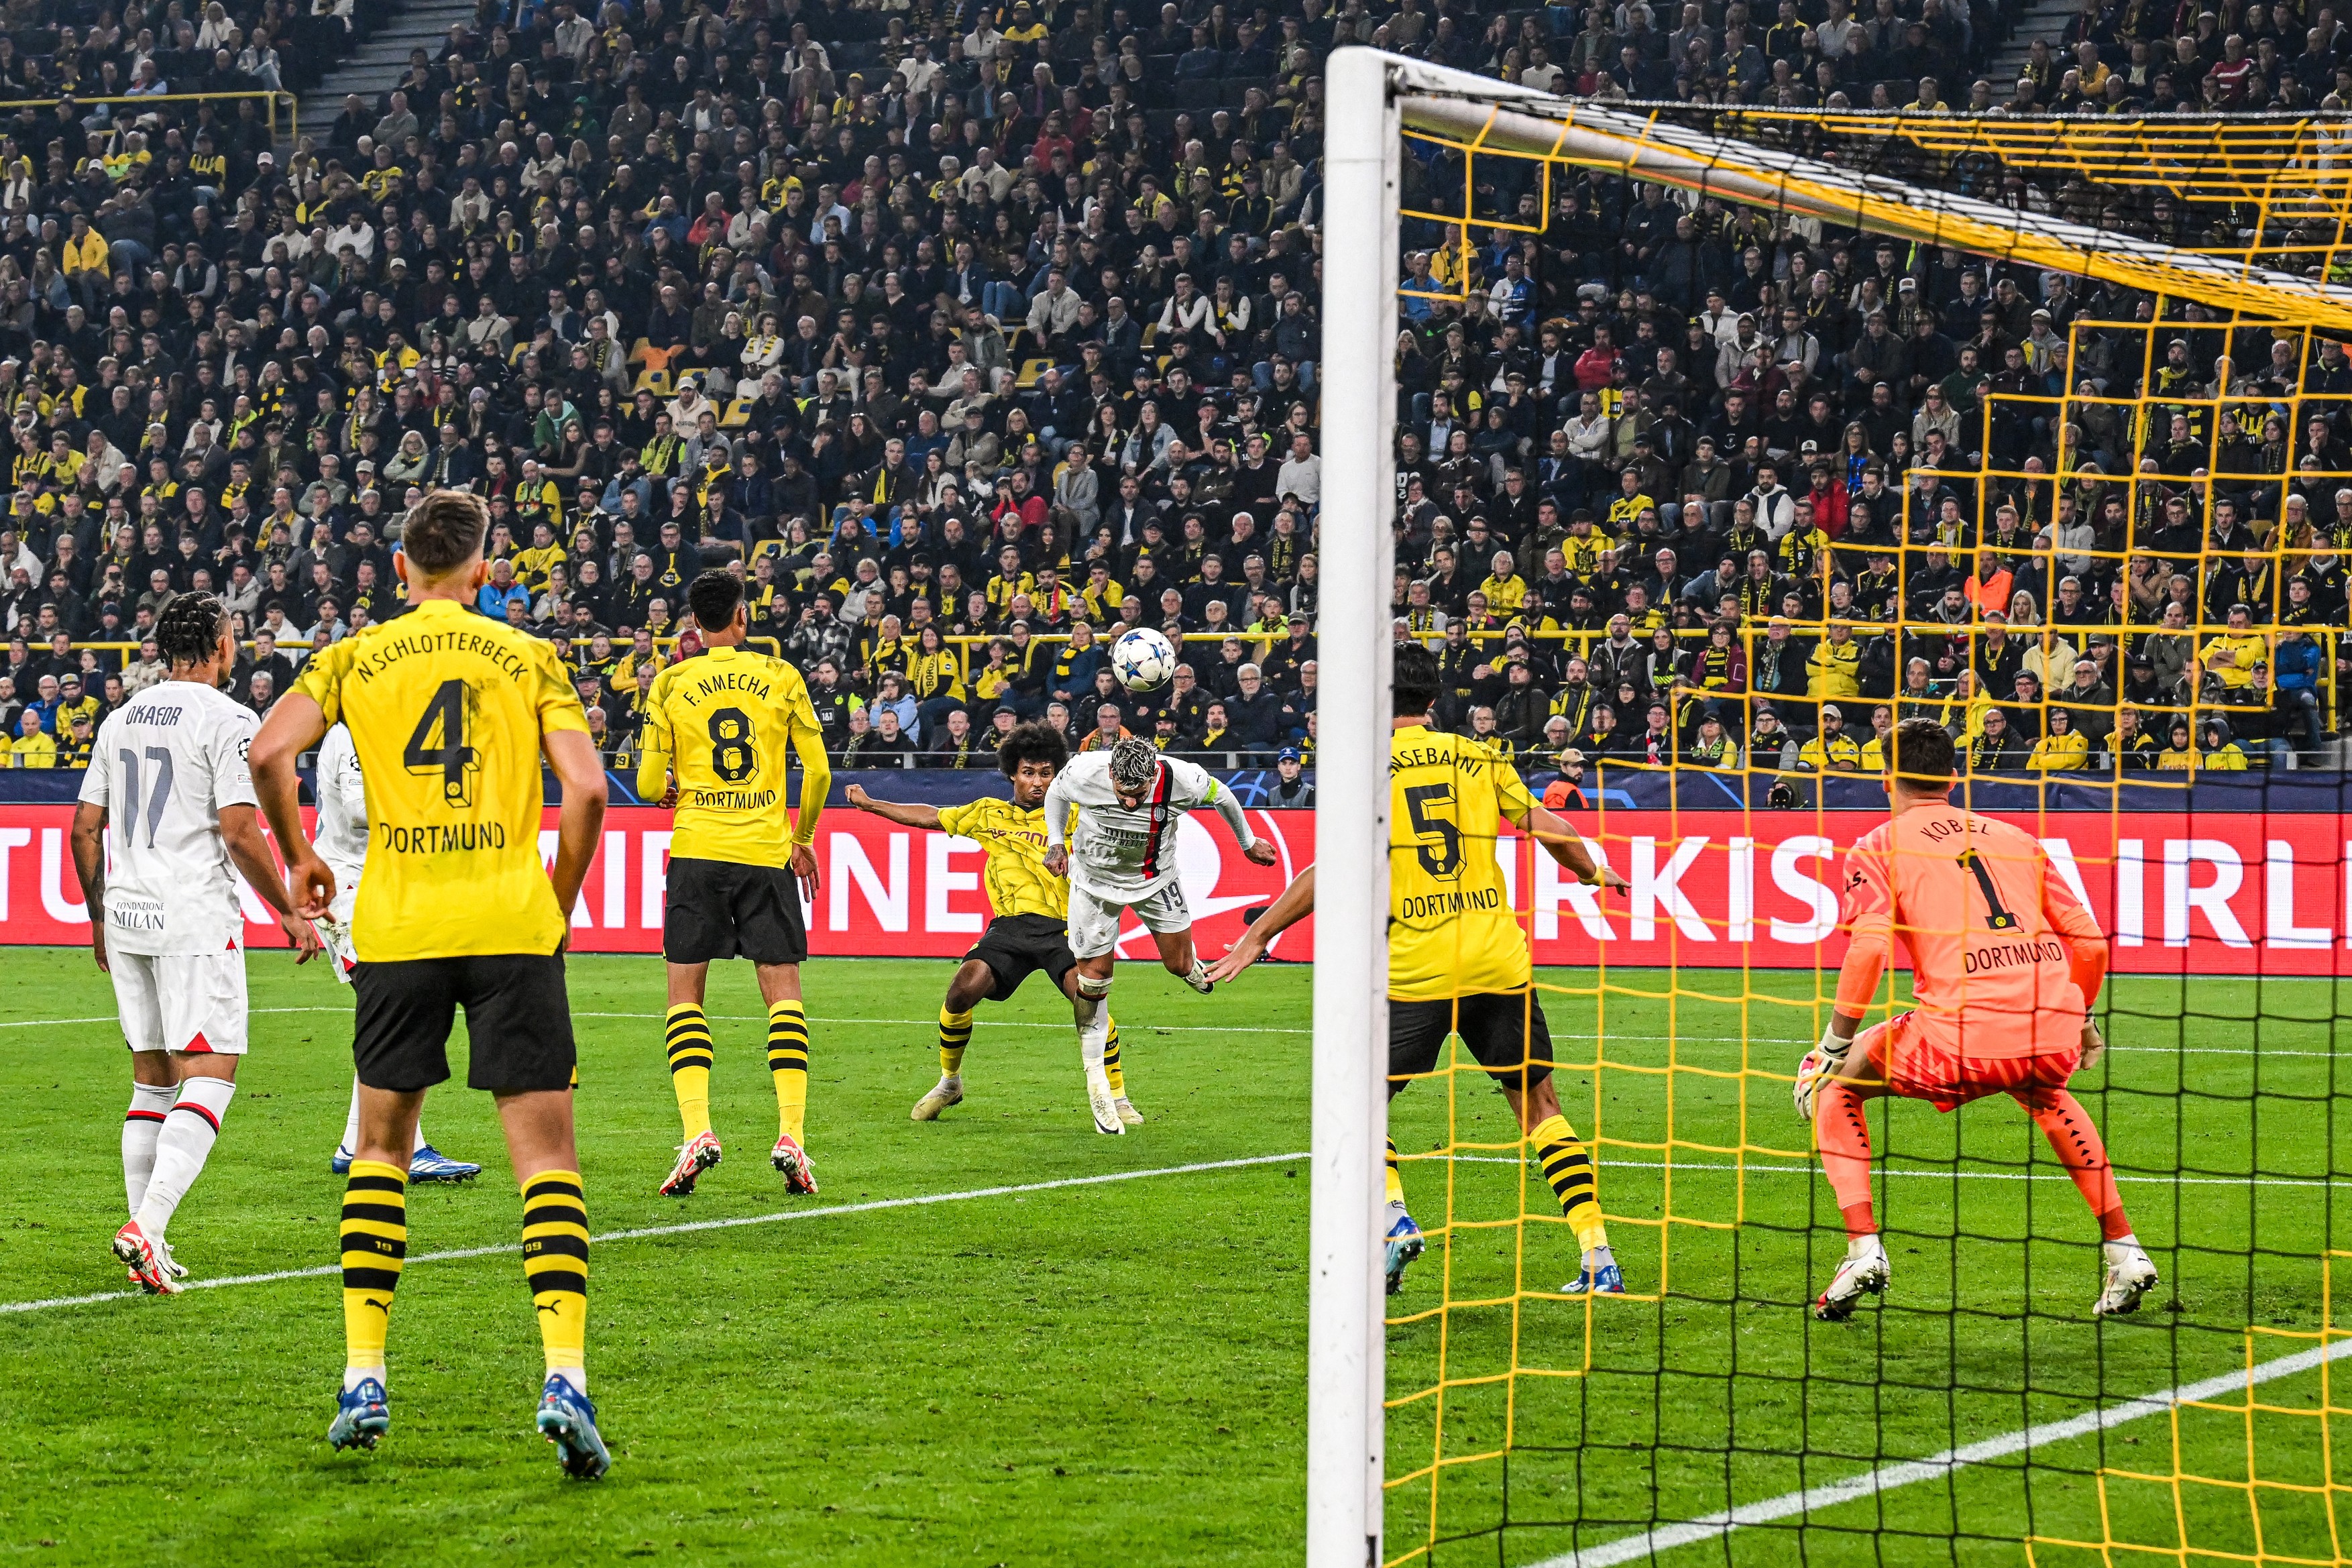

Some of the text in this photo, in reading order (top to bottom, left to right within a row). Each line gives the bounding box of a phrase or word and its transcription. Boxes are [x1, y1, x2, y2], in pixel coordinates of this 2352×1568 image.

[357, 632, 528, 683] N.SCHLOTTERBECK
[683, 673, 770, 706] F. NMECHA
[126, 706, 182, 726] OKAFOR
[404, 678, 482, 808] 4
[708, 707, 760, 786] 8
[1390, 748, 1483, 780] NSEBAINI
[119, 746, 174, 849] 17
[695, 790, 776, 809] DORTMUND
[380, 821, 505, 853] DORTMUND
[1404, 783, 1467, 882] 5
[1921, 820, 1990, 842] KOBEL
[116, 902, 165, 911] FONDAZIONE
[1160, 881, 1183, 911] 19
[1403, 888, 1499, 919] DORTMUND
[1956, 848, 2024, 936] 1
[113, 910, 164, 930] MILAN
[1964, 942, 2062, 974] DORTMUND
